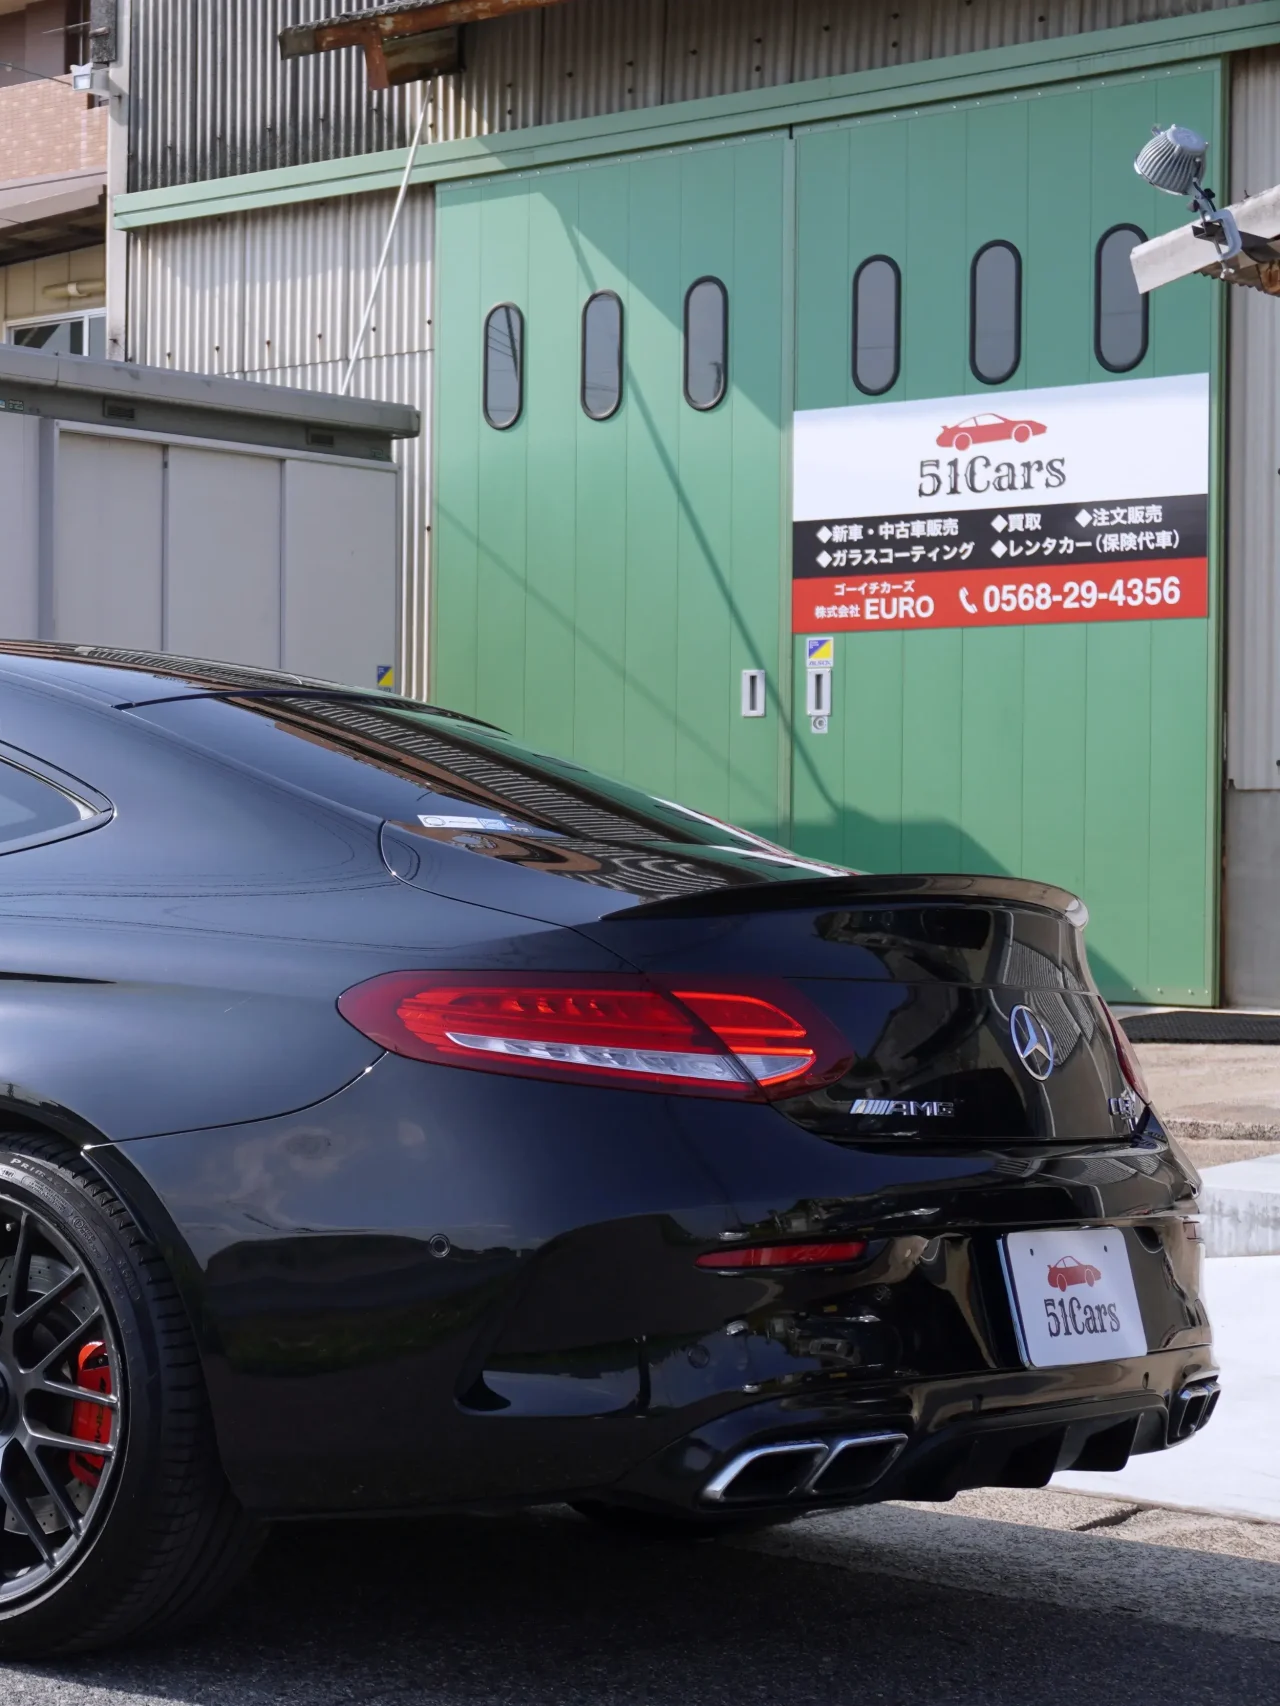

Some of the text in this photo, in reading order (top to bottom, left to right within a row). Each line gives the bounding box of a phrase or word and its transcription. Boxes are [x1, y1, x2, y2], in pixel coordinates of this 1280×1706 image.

[918, 455, 1067, 498] 51Cars
[1007, 513, 1042, 532] 買取
[1092, 504, 1163, 527] 注文販売
[834, 580, 915, 597] ゴーイチカーズ
[983, 575, 1181, 613] 0568-29-4356
[814, 595, 935, 620] 株式会社 EURO
[885, 1100, 954, 1117] AMG
[1043, 1296, 1121, 1338] 51Cars
